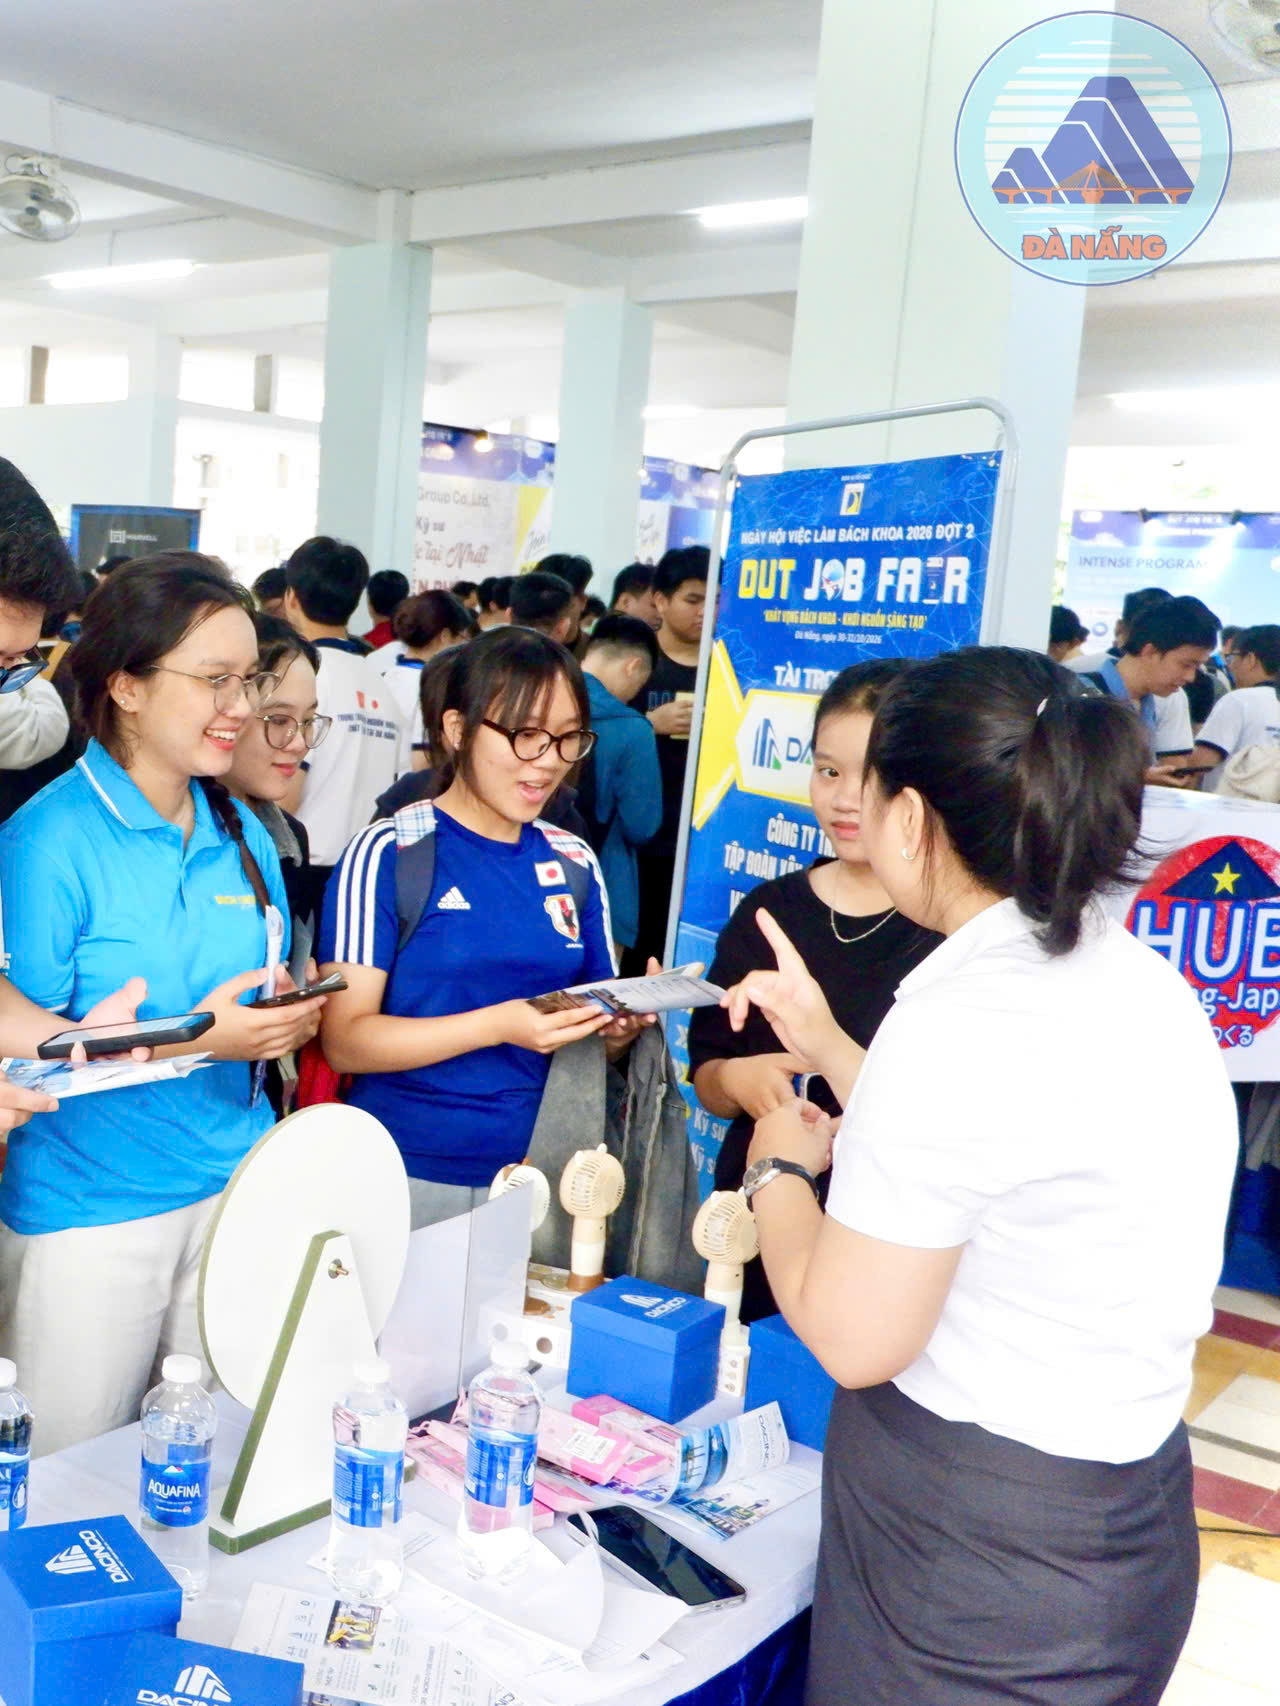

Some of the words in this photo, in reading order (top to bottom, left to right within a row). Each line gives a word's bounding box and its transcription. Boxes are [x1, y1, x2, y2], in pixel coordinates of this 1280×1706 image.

[741, 528, 768, 545] NGÀY
[768, 529, 787, 546] HỘI
[788, 526, 813, 546] VIỆC
[814, 524, 837, 543] LÀM
[838, 524, 870, 542] BÁCH
[871, 525, 905, 542] KHOA
[935, 521, 964, 543] ĐỢT
[964, 523, 976, 540] 2
[1079, 554, 1133, 569] INTENSE
[738, 559, 796, 600] DUT
[803, 557, 866, 602] JOB
[876, 556, 971, 605] FAIR
[774, 660, 801, 688] TÀI
[767, 811, 799, 849] CÔNG
[800, 823, 817, 853] TY
[724, 840, 745, 876] TẬP
[745, 848, 777, 881] ĐOÀN
[1194, 982, 1280, 1017] g-Jap
[694, 1106, 710, 1137] Kỹ
[147, 1478, 201, 1499] AQUAFINA
